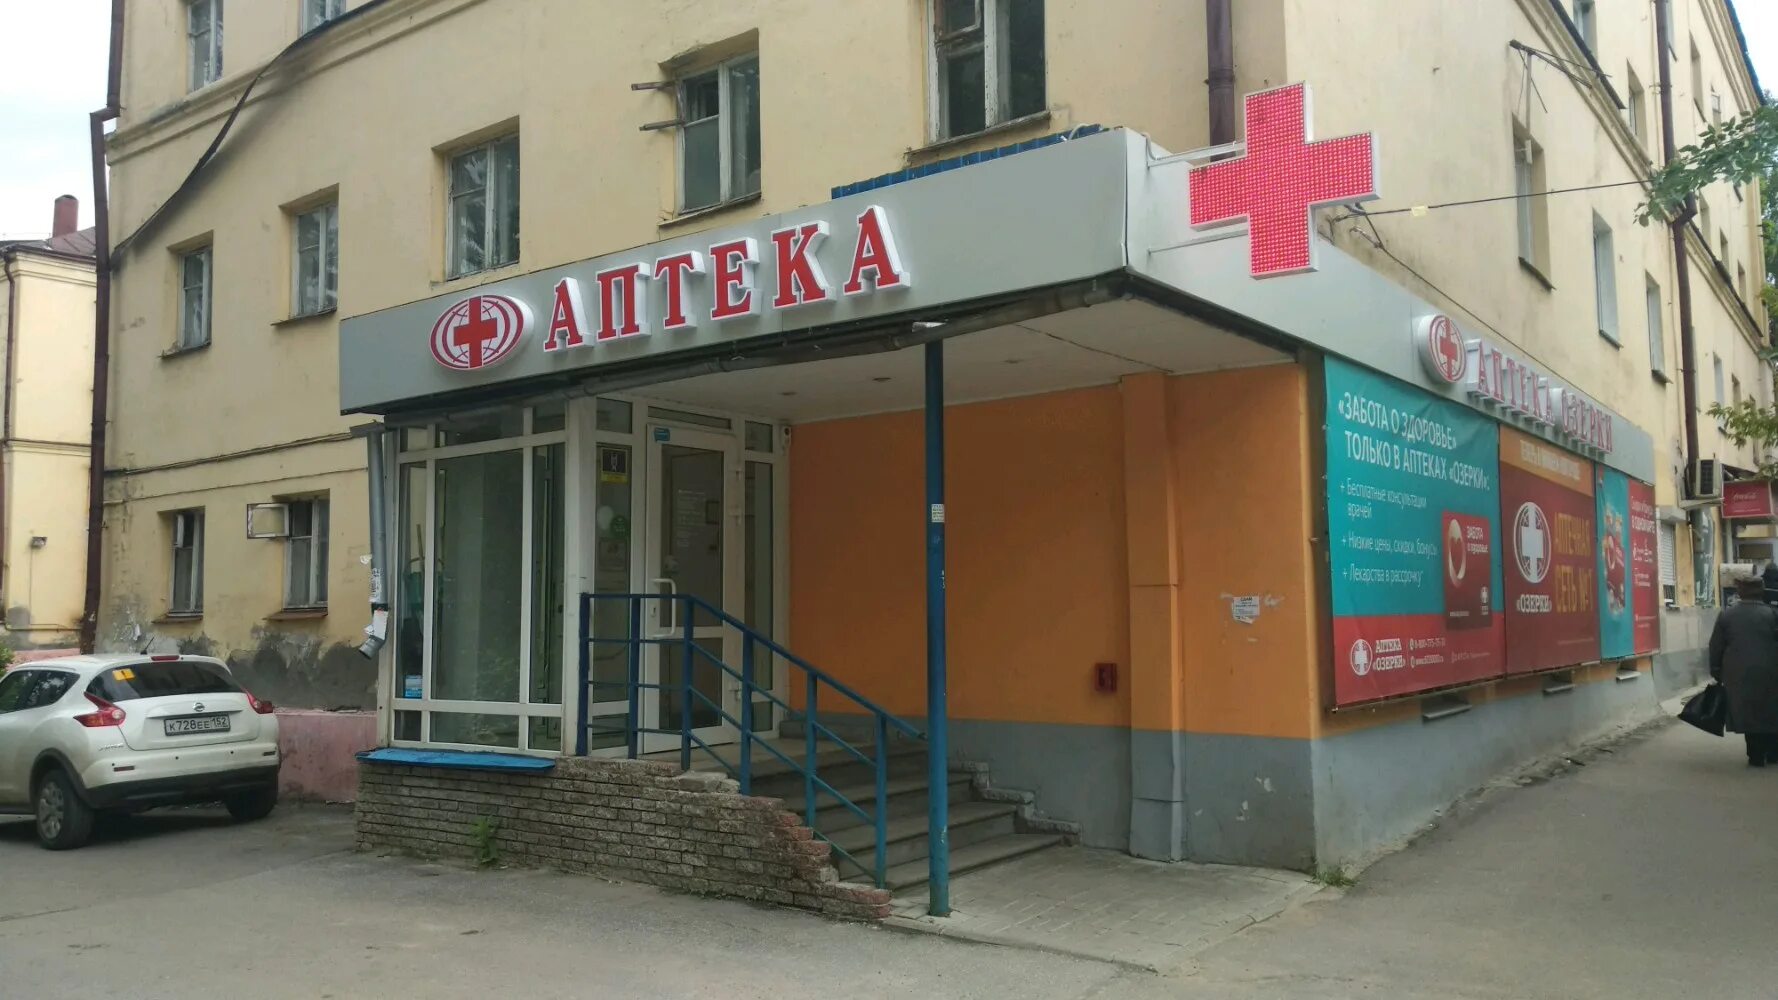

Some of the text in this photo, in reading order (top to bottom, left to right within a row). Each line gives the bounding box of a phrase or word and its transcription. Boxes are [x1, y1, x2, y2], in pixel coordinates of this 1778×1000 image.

[542, 204, 911, 352] АПТЕКА
[1468, 338, 1555, 426] АПТЕКА
[1338, 391, 1457, 450] «ЗАБОТА О ЗДОРОВЬЕ»
[1344, 430, 1391, 468] ТОЛЬКО
[1393, 444, 1400, 470] В
[1403, 449, 1447, 481] АПТЕКАХ
[211, 717, 227, 728] 152
